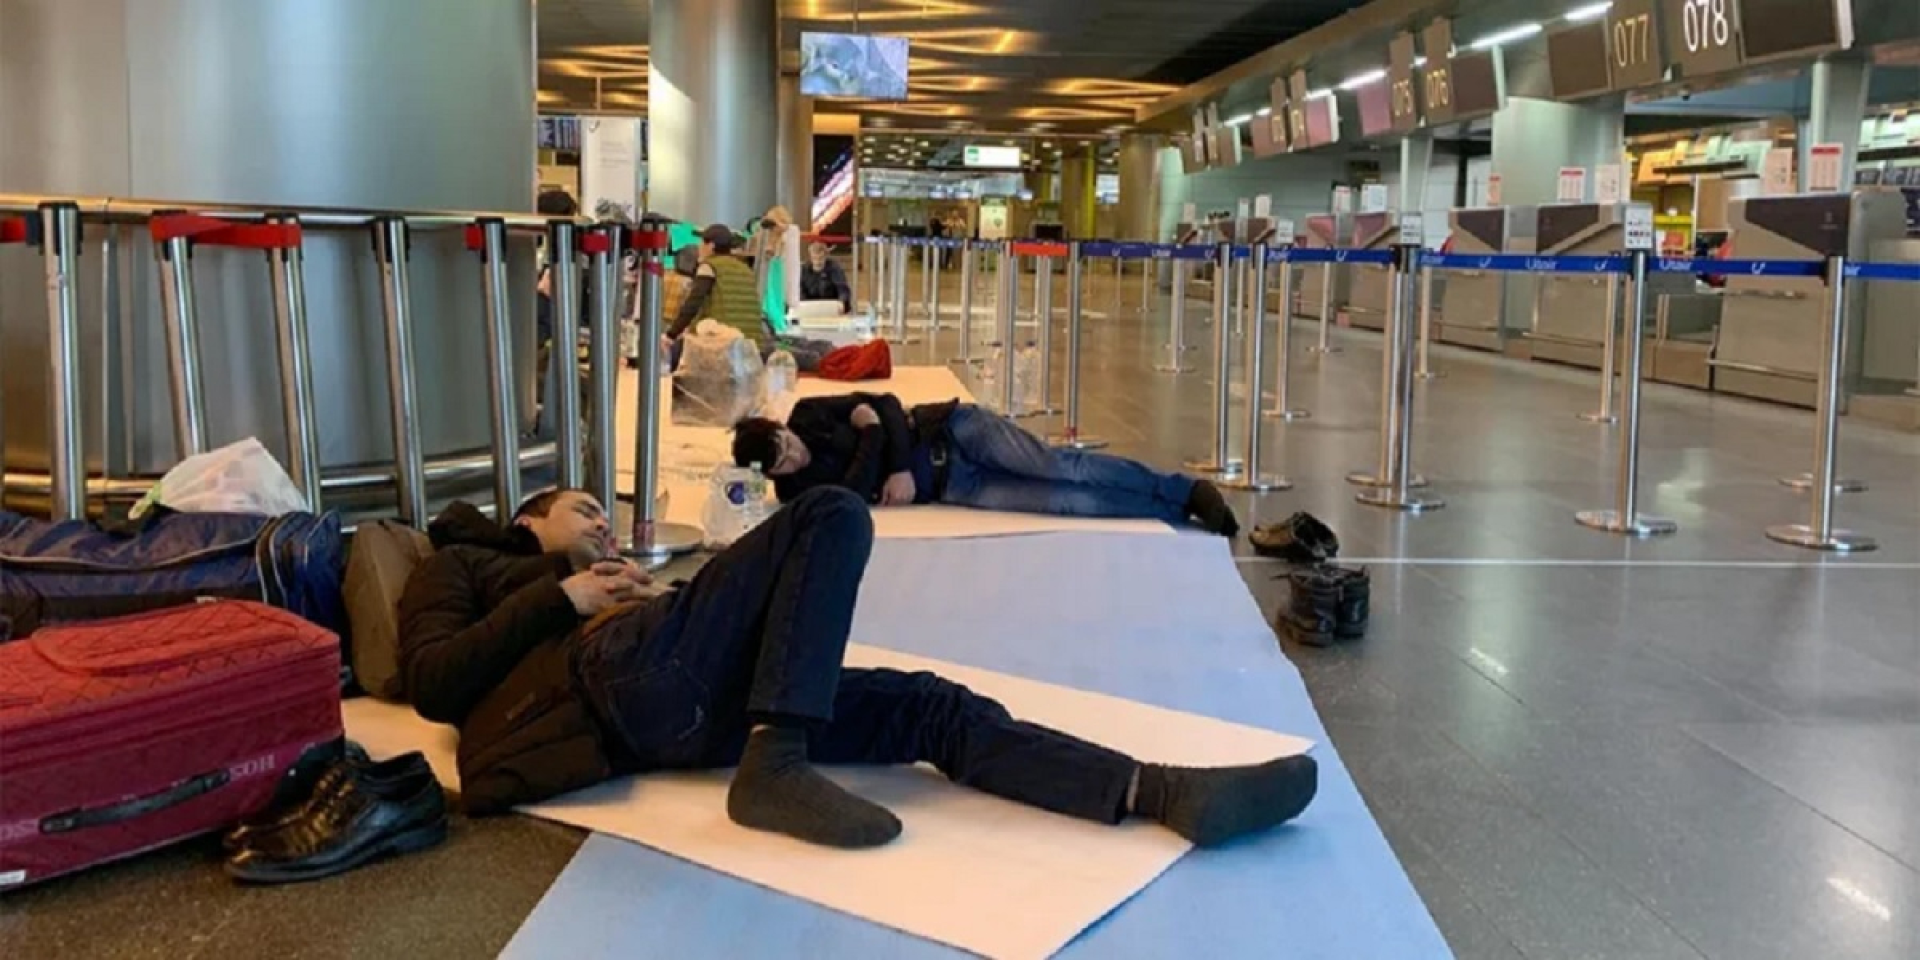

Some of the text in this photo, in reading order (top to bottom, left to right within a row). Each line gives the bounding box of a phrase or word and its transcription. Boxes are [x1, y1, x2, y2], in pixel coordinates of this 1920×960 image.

[1613, 13, 1649, 67] 077
[1683, 0, 1729, 52] 078
[1427, 68, 1449, 108] 076
[1525, 256, 1557, 270] Utair
